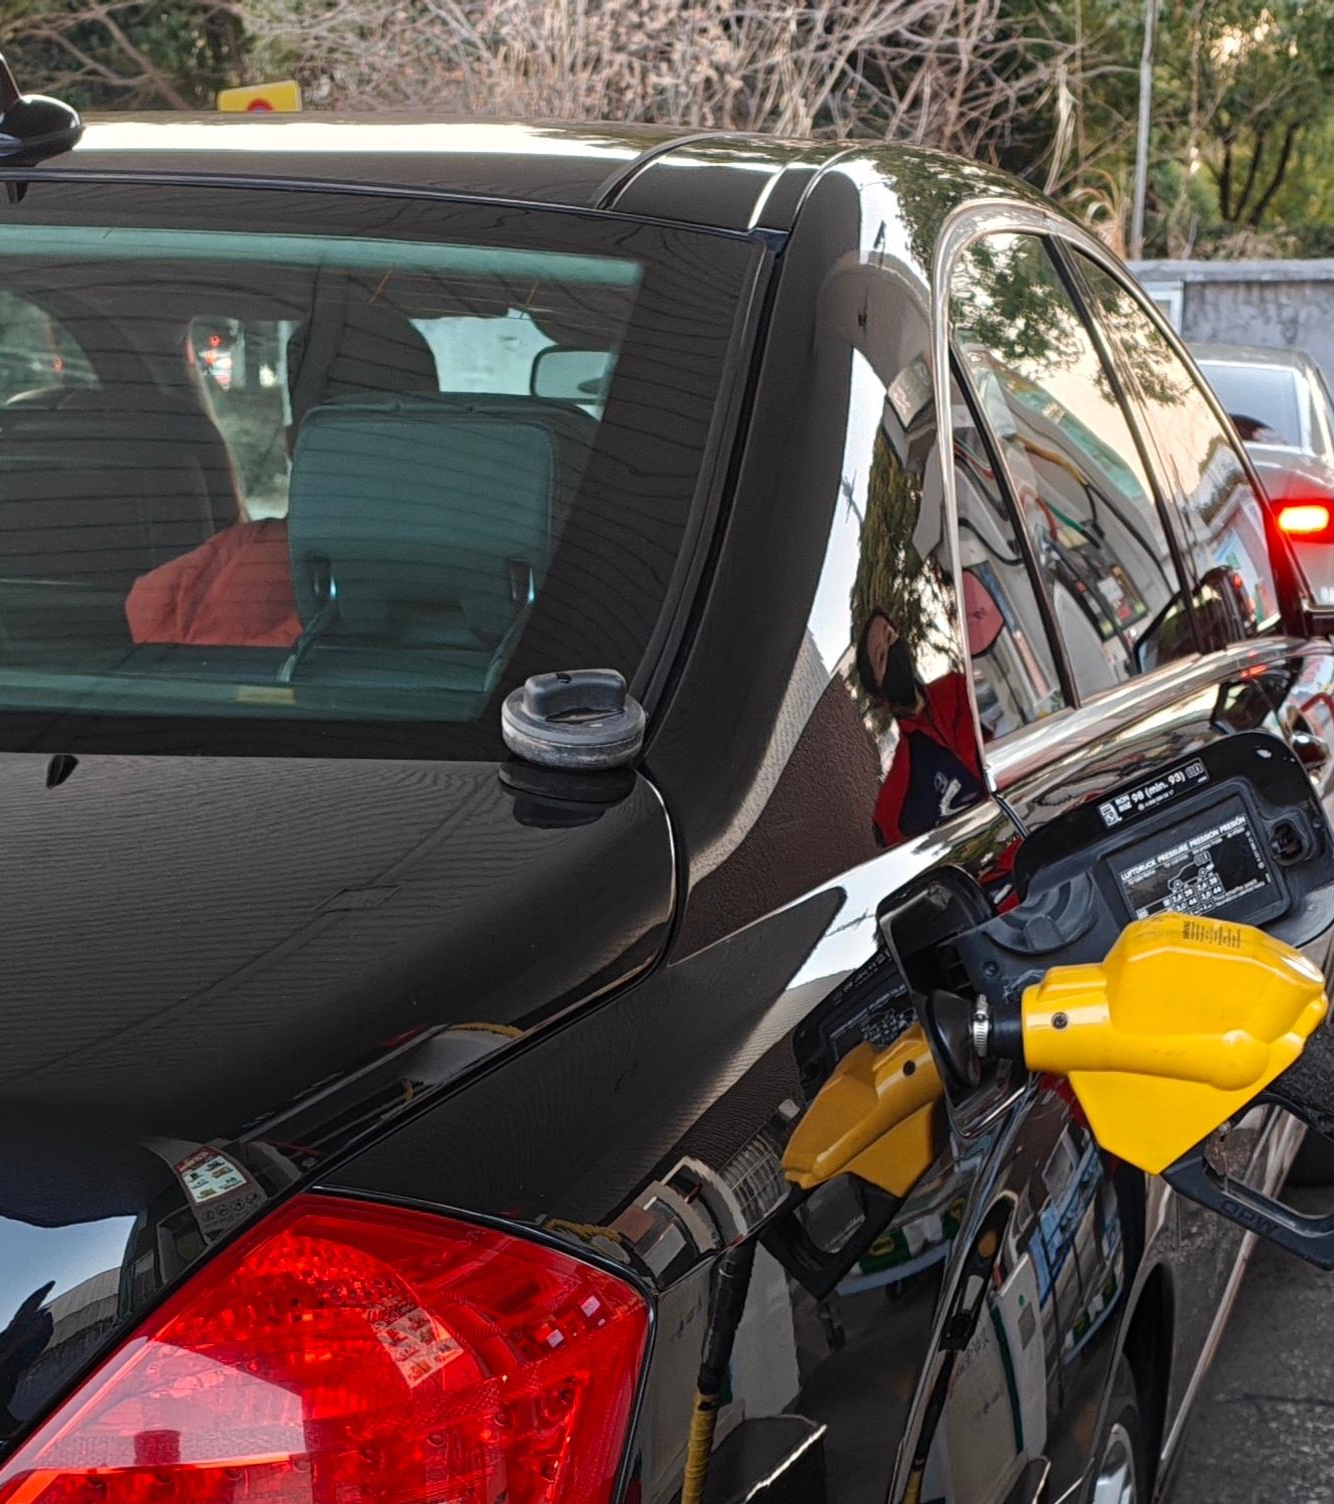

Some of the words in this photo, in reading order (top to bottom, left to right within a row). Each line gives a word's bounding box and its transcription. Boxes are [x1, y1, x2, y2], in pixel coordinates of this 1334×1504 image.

[1131, 790, 1145, 803] 98
[1144, 781, 1169, 799] (min.
[1168, 771, 1186, 785] 93)
[1156, 843, 1189, 864] PRESSURE
[1189, 829, 1220, 848] PRESSION
